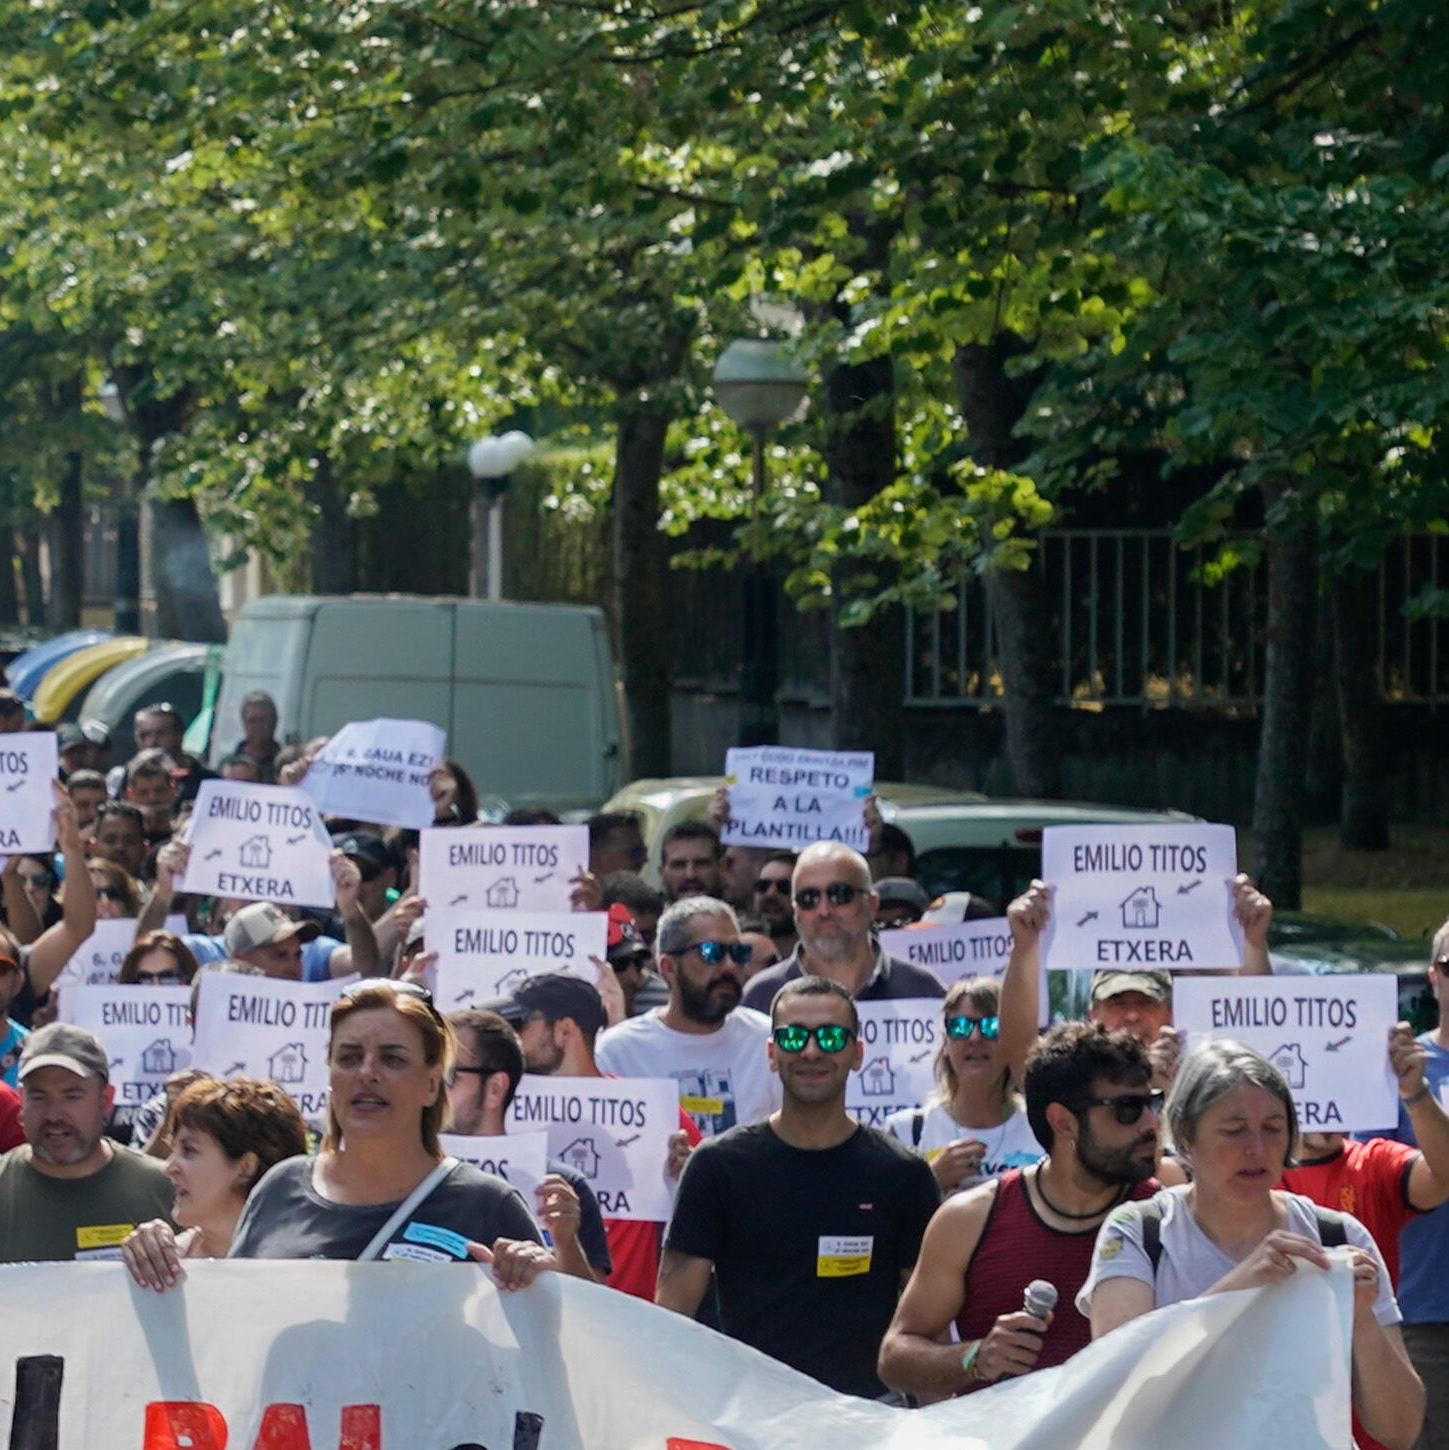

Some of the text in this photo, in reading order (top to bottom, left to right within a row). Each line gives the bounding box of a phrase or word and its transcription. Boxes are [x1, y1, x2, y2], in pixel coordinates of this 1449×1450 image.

[750, 767, 850, 789] RESPETO
[208, 796, 312, 829] EMILIO TITOS
[773, 796, 822, 814] A LA
[450, 843, 559, 867] EMILIO TITOS
[1074, 844, 1207, 874] EMILIO TITOS
[217, 872, 294, 898] ETXERA
[454, 928, 576, 958] EMILIO TITOS
[1097, 939, 1194, 963] ETXERA
[102, 1002, 161, 1025] EMILIO
[228, 993, 330, 1029] EMILIO TIT
[1212, 997, 1358, 1029] EMILIO TITOS
[882, 1018, 935, 1044] TITOS
[514, 1095, 647, 1128] EMILIO TITOS
